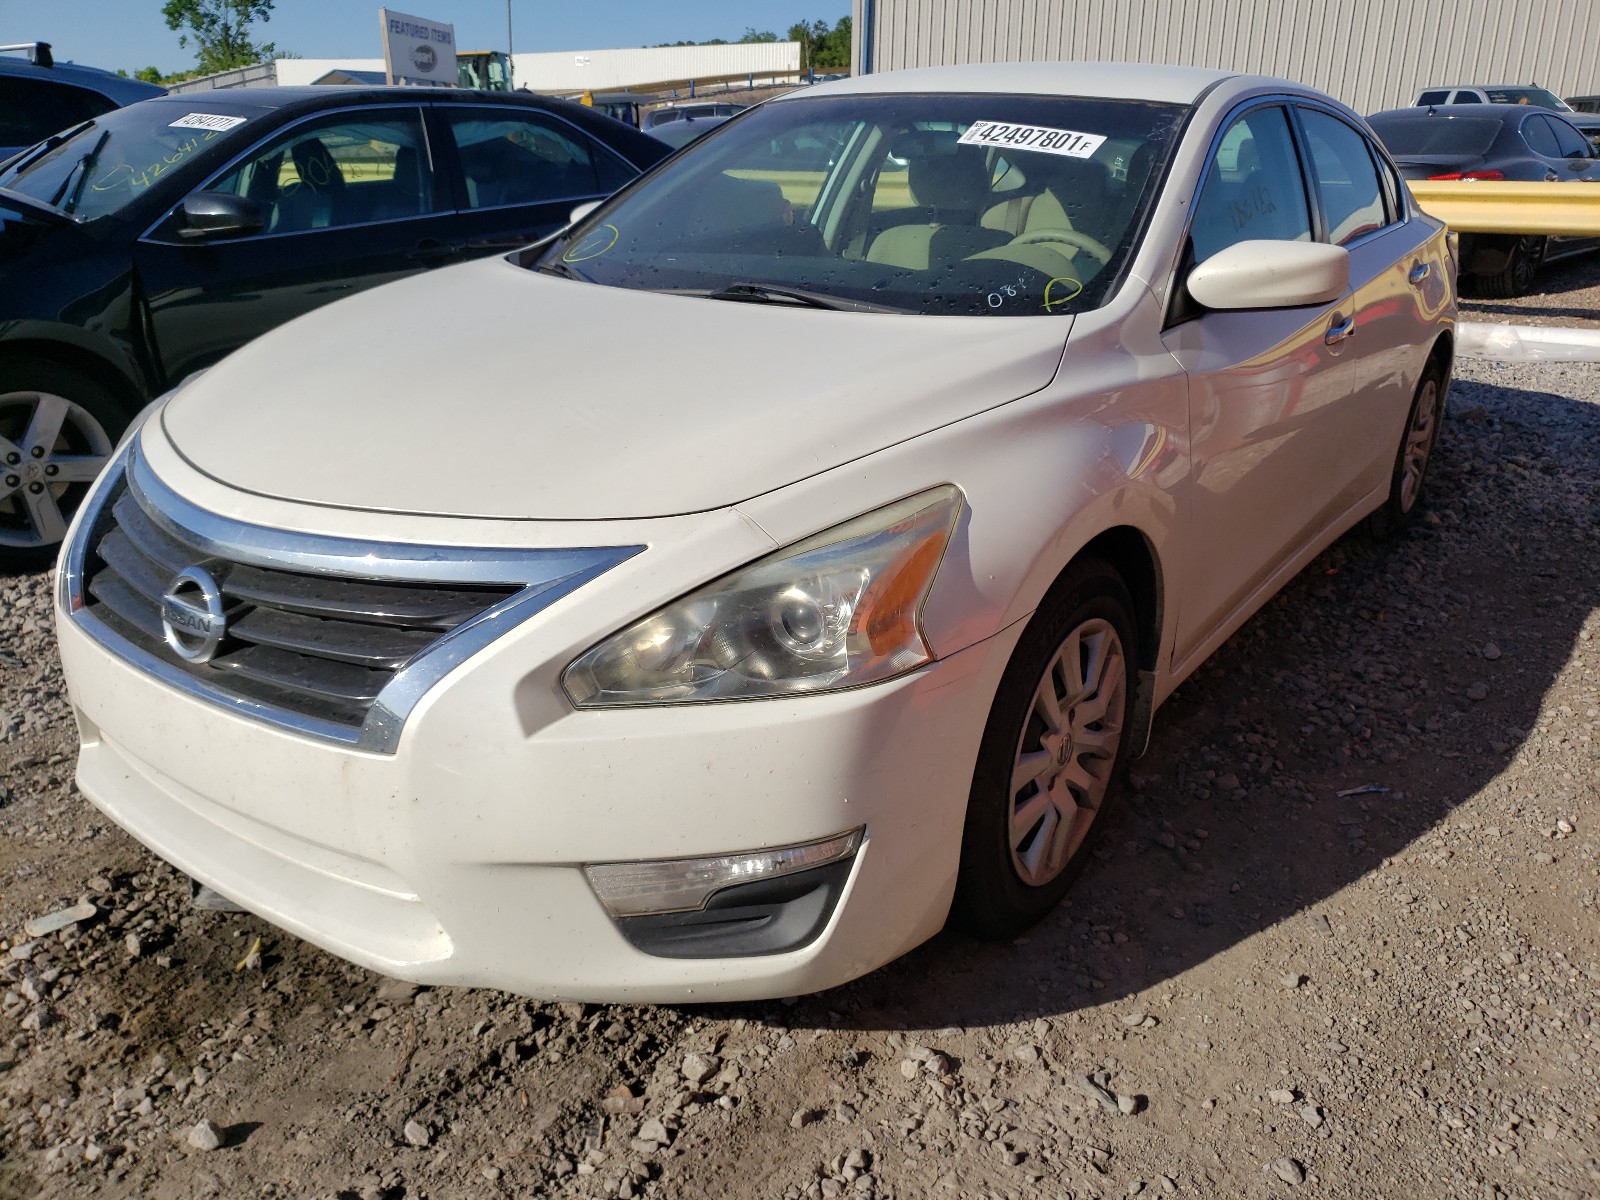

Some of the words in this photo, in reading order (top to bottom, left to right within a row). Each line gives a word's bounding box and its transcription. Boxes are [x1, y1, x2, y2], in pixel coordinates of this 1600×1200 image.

[390, 20, 429, 39] FEATURED
[431, 29, 451, 45] ITEMS
[979, 125, 1084, 151] 42497801
[1079, 142, 1092, 151] F
